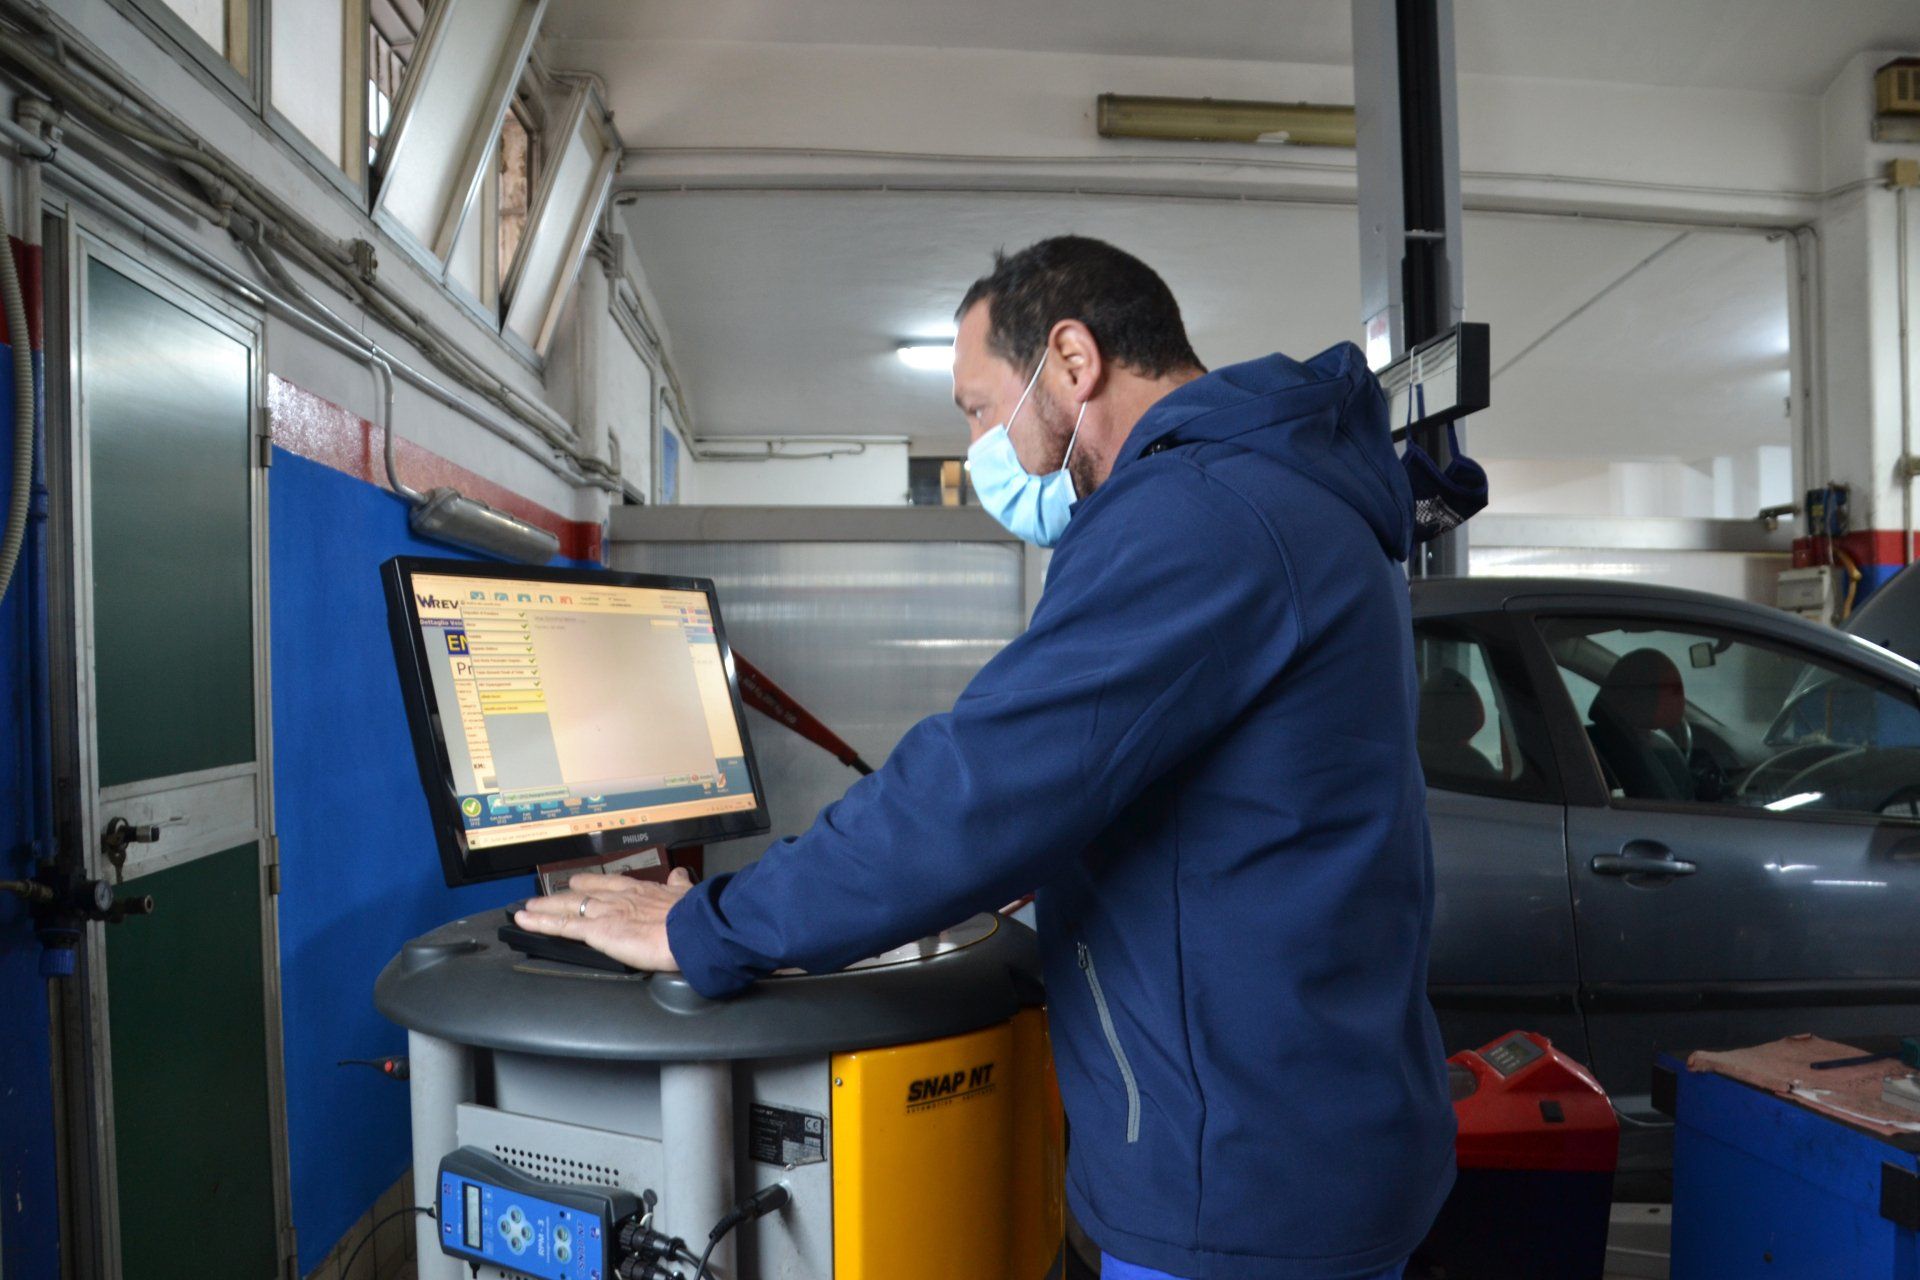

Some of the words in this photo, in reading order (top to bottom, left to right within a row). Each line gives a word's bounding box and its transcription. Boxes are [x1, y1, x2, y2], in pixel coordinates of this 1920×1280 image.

[622, 832, 649, 844] PHILIPS
[907, 1071, 966, 1102] SNAP
[969, 1063, 994, 1088] NT
[537, 1233, 545, 1256] RPM
